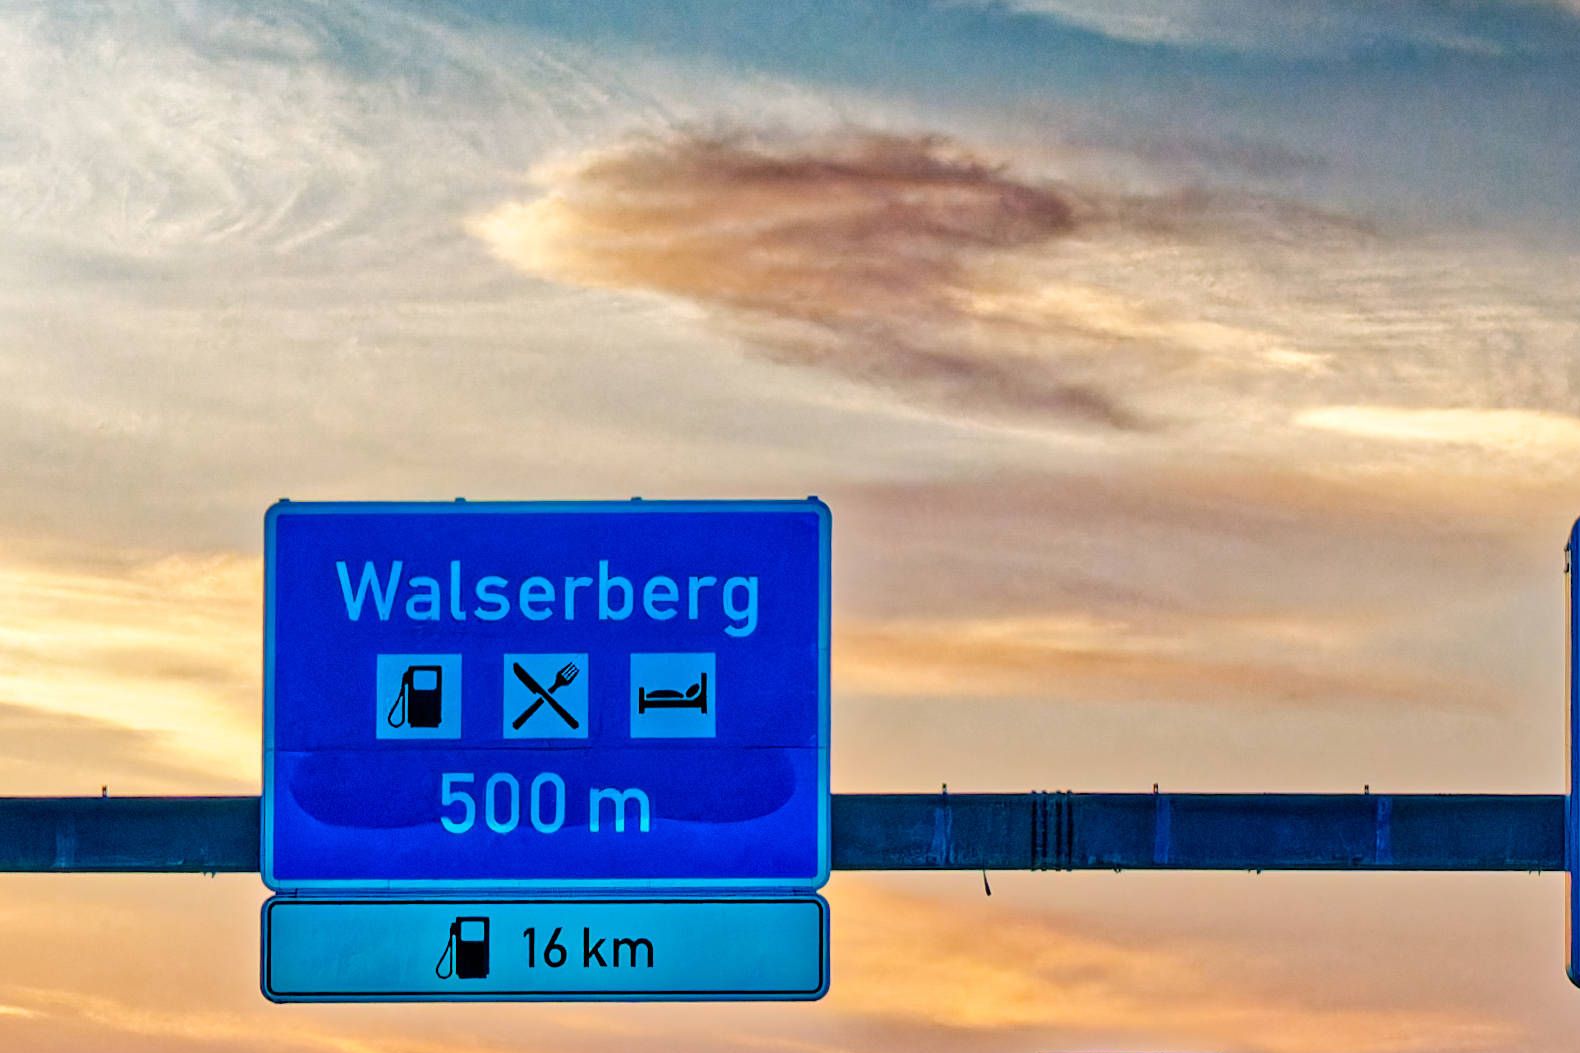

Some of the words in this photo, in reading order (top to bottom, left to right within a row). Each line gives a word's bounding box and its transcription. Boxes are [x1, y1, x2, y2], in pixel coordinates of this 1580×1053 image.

[336, 559, 759, 638] Walserberg
[439, 772, 566, 834] 500
[588, 784, 652, 833] m
[522, 927, 568, 968] 16
[583, 926, 655, 968] km
